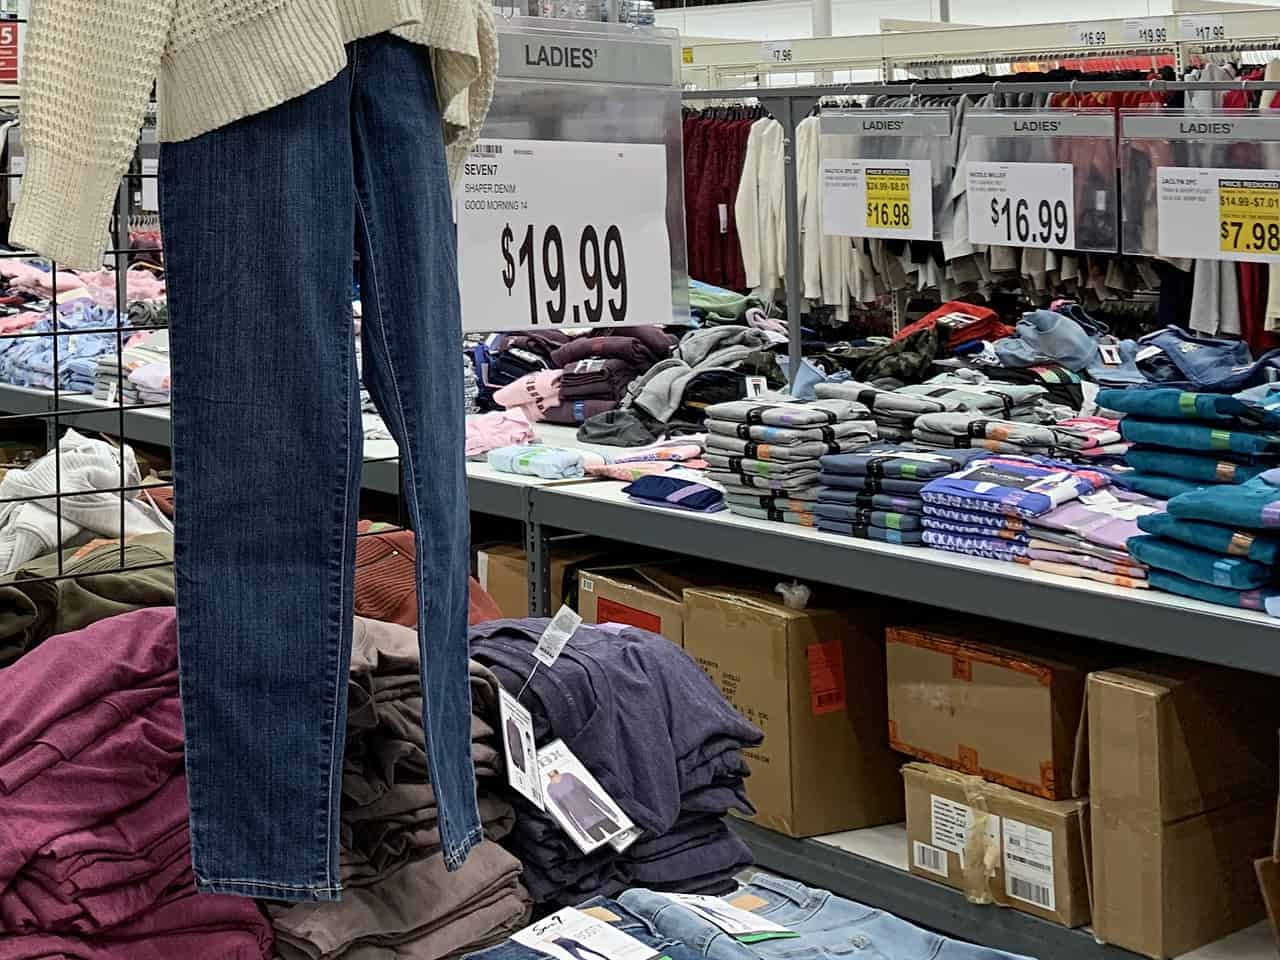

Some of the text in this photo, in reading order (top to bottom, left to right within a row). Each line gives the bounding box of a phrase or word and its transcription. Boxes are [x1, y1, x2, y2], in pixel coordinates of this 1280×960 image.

[525, 44, 598, 69] LADIES'
[863, 121, 904, 130] LADIES'
[1014, 121, 1061, 131] LADIES'
[1180, 123, 1234, 134] LADIES'
[867, 203, 910, 226] $16.98
[991, 197, 1068, 244] $16.99
[1220, 221, 1280, 251] $7.98
[501, 223, 628, 324] $19.99
